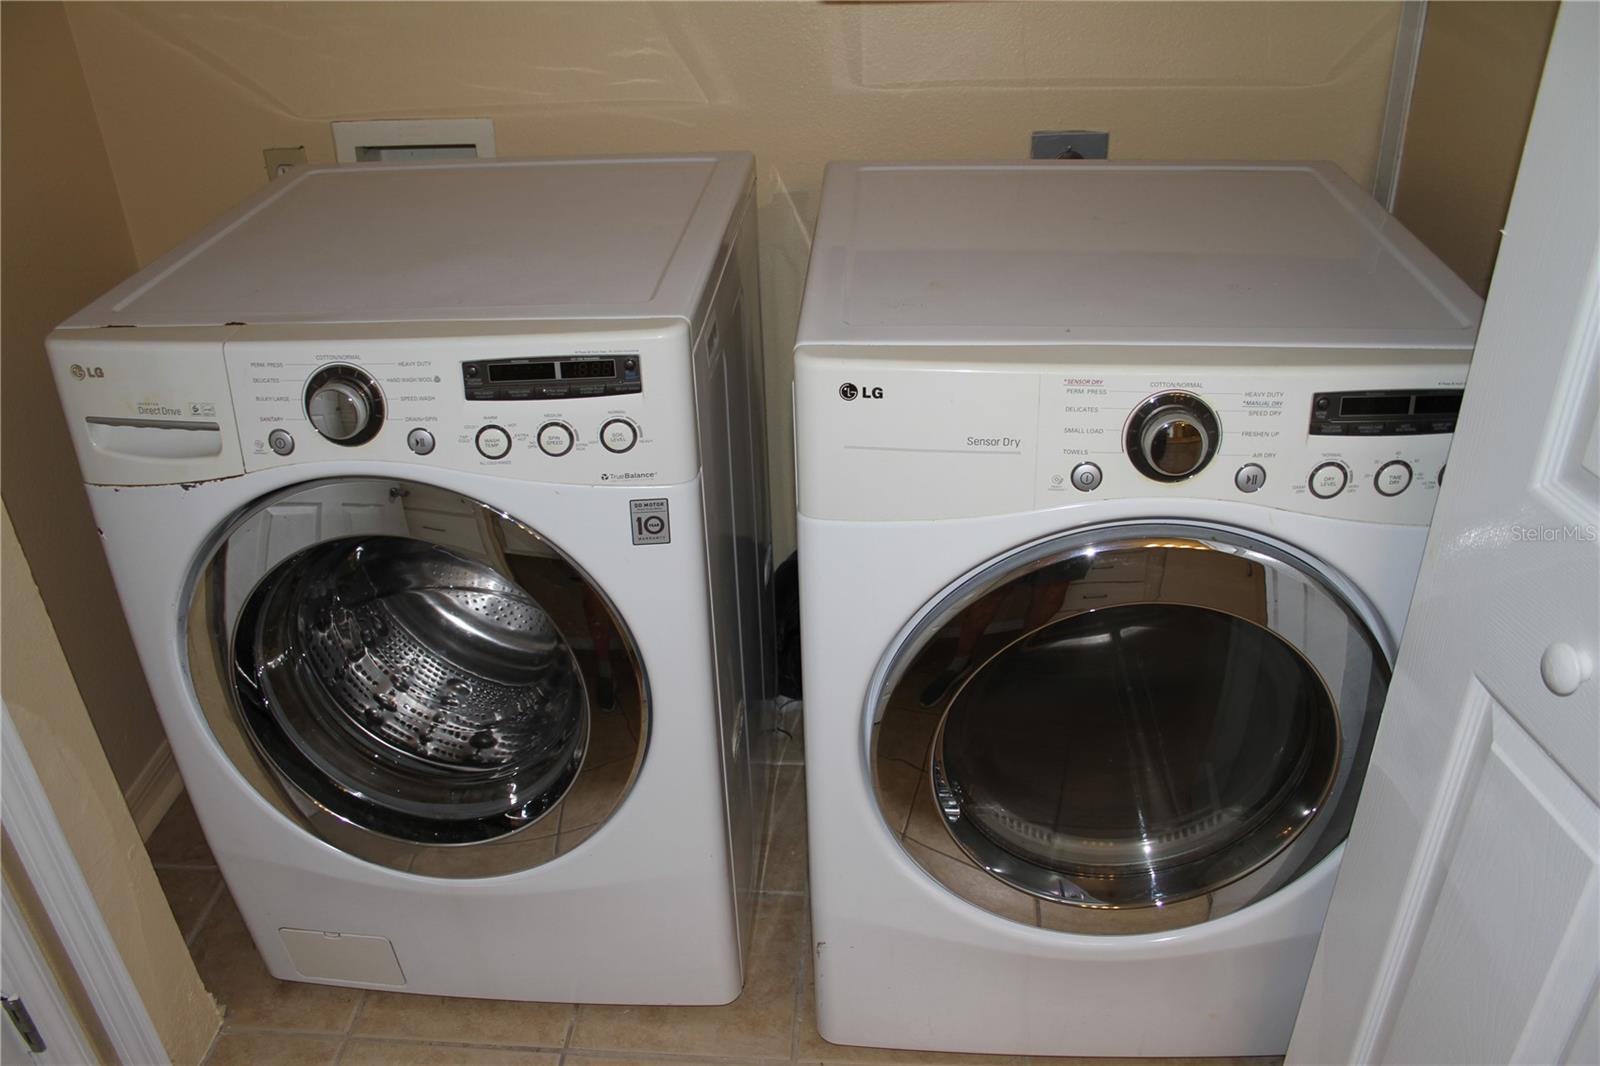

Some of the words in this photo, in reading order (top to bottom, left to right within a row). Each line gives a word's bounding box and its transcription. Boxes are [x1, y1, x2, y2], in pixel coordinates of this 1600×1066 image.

[87, 367, 105, 378] LG
[862, 387, 884, 399] LG
[138, 406, 161, 415] Direct
[161, 406, 182, 416] Drive
[966, 436, 1000, 447] Sensor
[1002, 437, 1021, 448] Dry
[636, 516, 665, 535] 10
